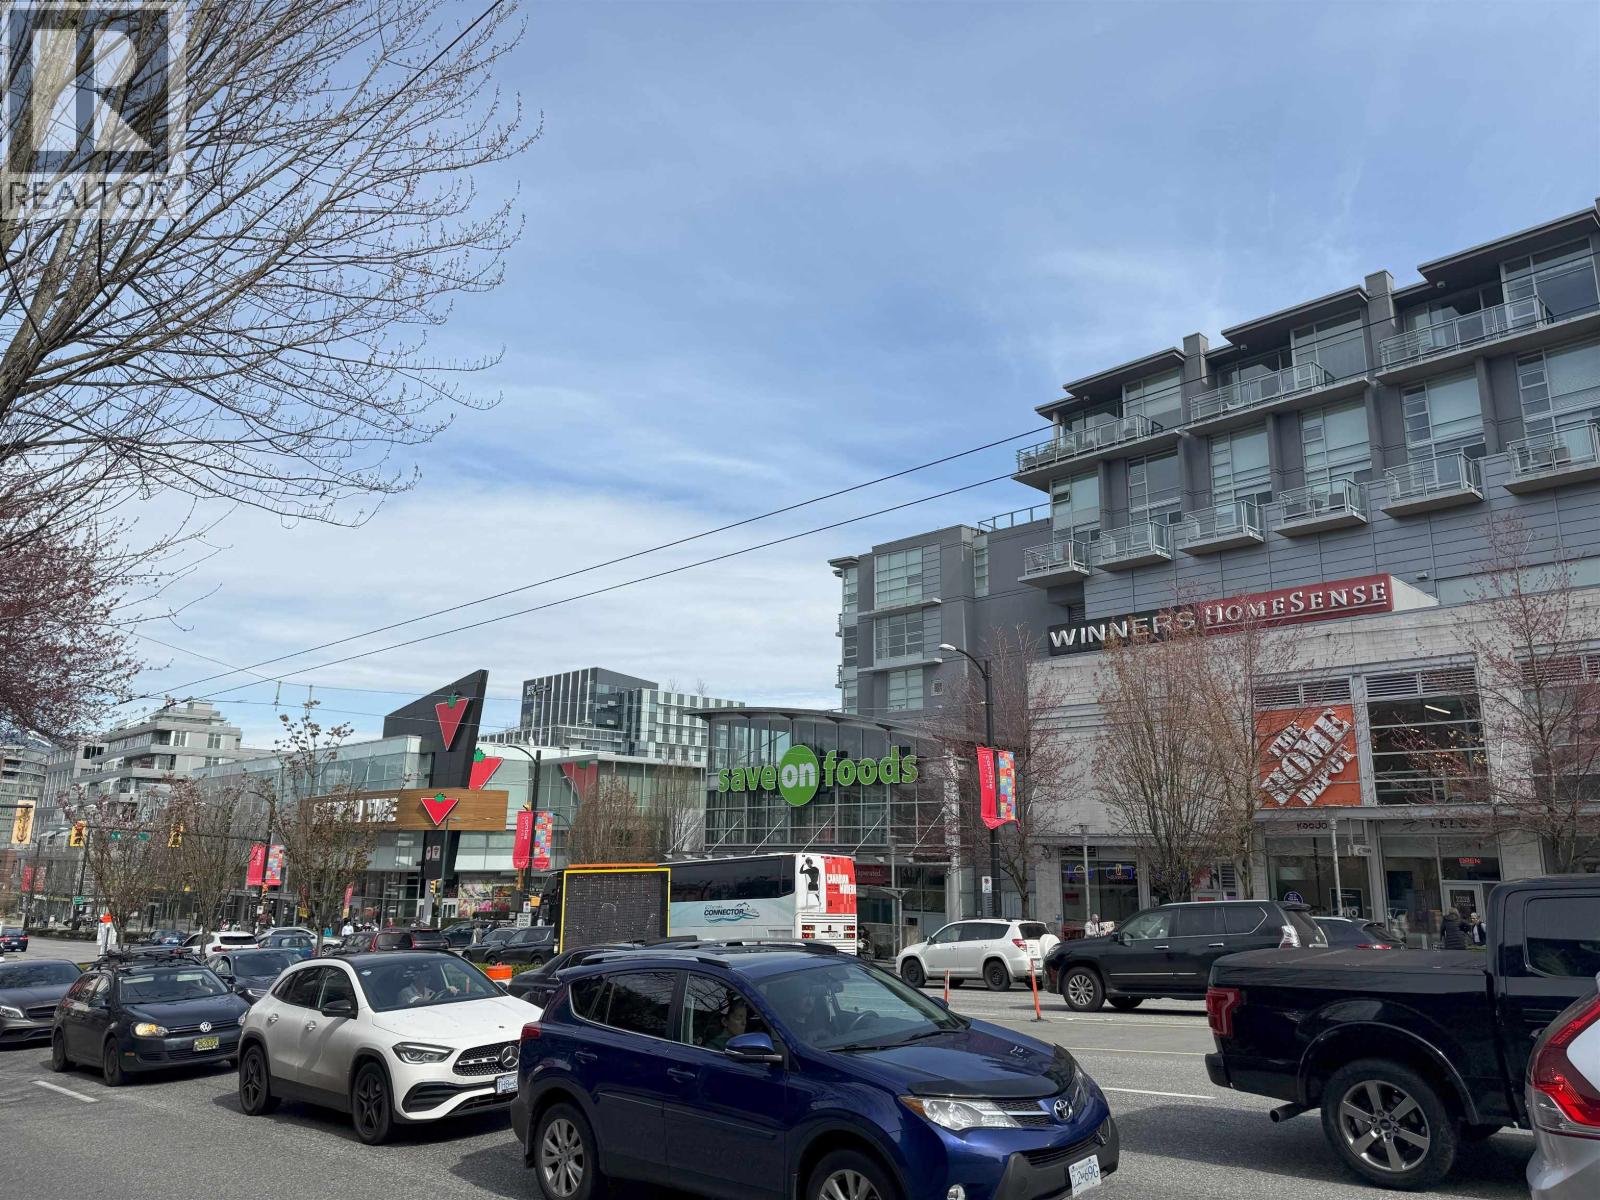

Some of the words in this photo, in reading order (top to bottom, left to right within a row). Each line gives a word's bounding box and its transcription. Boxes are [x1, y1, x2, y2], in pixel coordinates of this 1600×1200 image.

[1050, 611, 1196, 648] WINNERS
[1260, 708, 1351, 805] HOME
[1267, 720, 1305, 758] THE
[718, 764, 776, 793] save
[781, 762, 816, 788] on
[823, 745, 919, 787] foods
[1296, 744, 1354, 806] DEPOT
[704, 908, 744, 916] CONNECTOR
